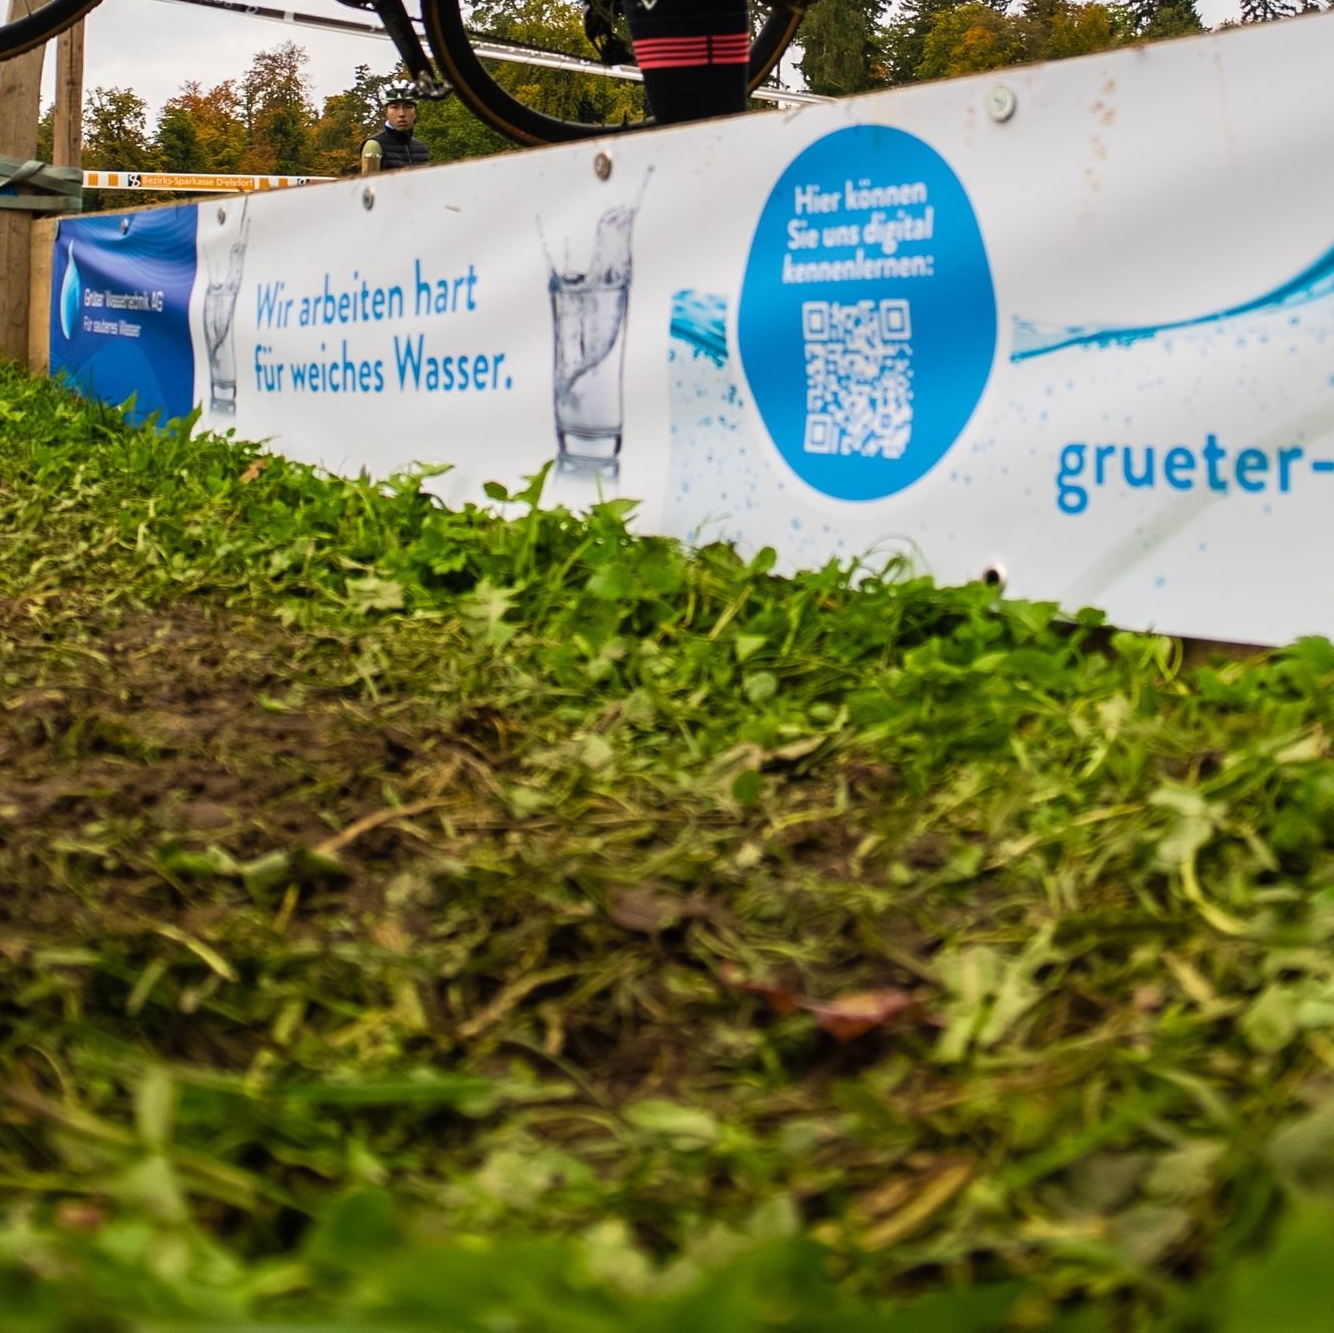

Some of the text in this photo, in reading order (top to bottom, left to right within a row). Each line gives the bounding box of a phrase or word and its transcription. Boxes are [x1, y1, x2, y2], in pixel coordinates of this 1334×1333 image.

[142, 176, 253, 187] Bezirks-Sparkasse Dielsdorf
[794, 178, 927, 215] Hier können
[787, 206, 934, 254] Sie uns digital
[782, 248, 934, 284] kennenlernen:
[151, 291, 164, 312] AG
[256, 258, 477, 329] Wir arbeiten hart
[255, 333, 512, 392] für weiches Wasser.
